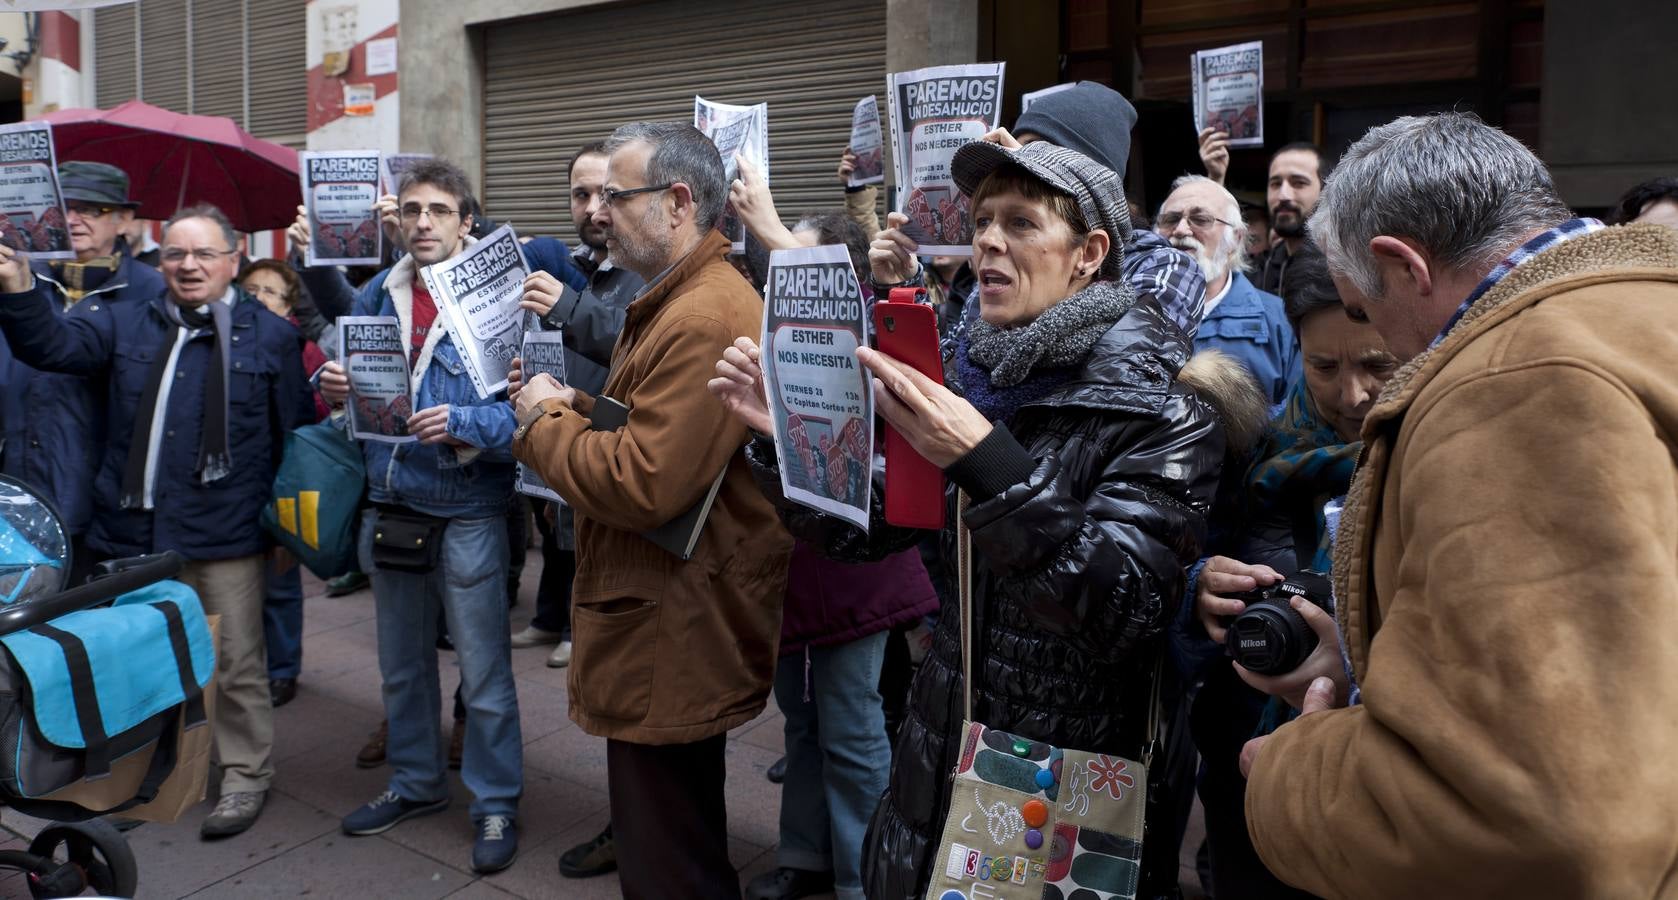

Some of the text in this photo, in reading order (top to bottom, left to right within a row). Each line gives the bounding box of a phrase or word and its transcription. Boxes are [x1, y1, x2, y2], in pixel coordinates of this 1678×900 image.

[1206, 51, 1258, 67] PAREMOS
[905, 79, 996, 105] PAREMOS
[908, 101, 992, 120] UN DESAHUCIO
[924, 123, 962, 135] ESTHER
[0, 131, 48, 151] REMOS
[915, 138, 976, 152] NOS NECESIT
[311, 158, 377, 172] PAREMOS
[311, 172, 377, 182] UN DESAHUCIO
[945, 210, 959, 232] STOP
[444, 236, 515, 287] PAREMOS
[450, 251, 519, 297] UN DESAHUCIO
[775, 267, 858, 299] PAREMOS
[477, 275, 510, 299] ESTHER
[468, 300, 488, 316] NOS
[488, 279, 523, 306] NECESITA
[774, 299, 859, 321] UN DESAHUCIO
[348, 341, 404, 351] UN DESAHUC
[792, 329, 834, 346] ESTHER
[363, 355, 393, 363] ESTHER
[526, 343, 562, 364] PAREMOS
[778, 350, 854, 370] NOS NECESITA
[352, 365, 367, 373] NOS
[784, 383, 860, 401] VIERNES 28 13h
[794, 397, 821, 410] Capitan
[821, 400, 845, 413] Cortes
[850, 419, 869, 455] STOP
[829, 452, 844, 480] STOP
[1281, 583, 1306, 596] Nikon
[1240, 639, 1267, 648] Nikon
